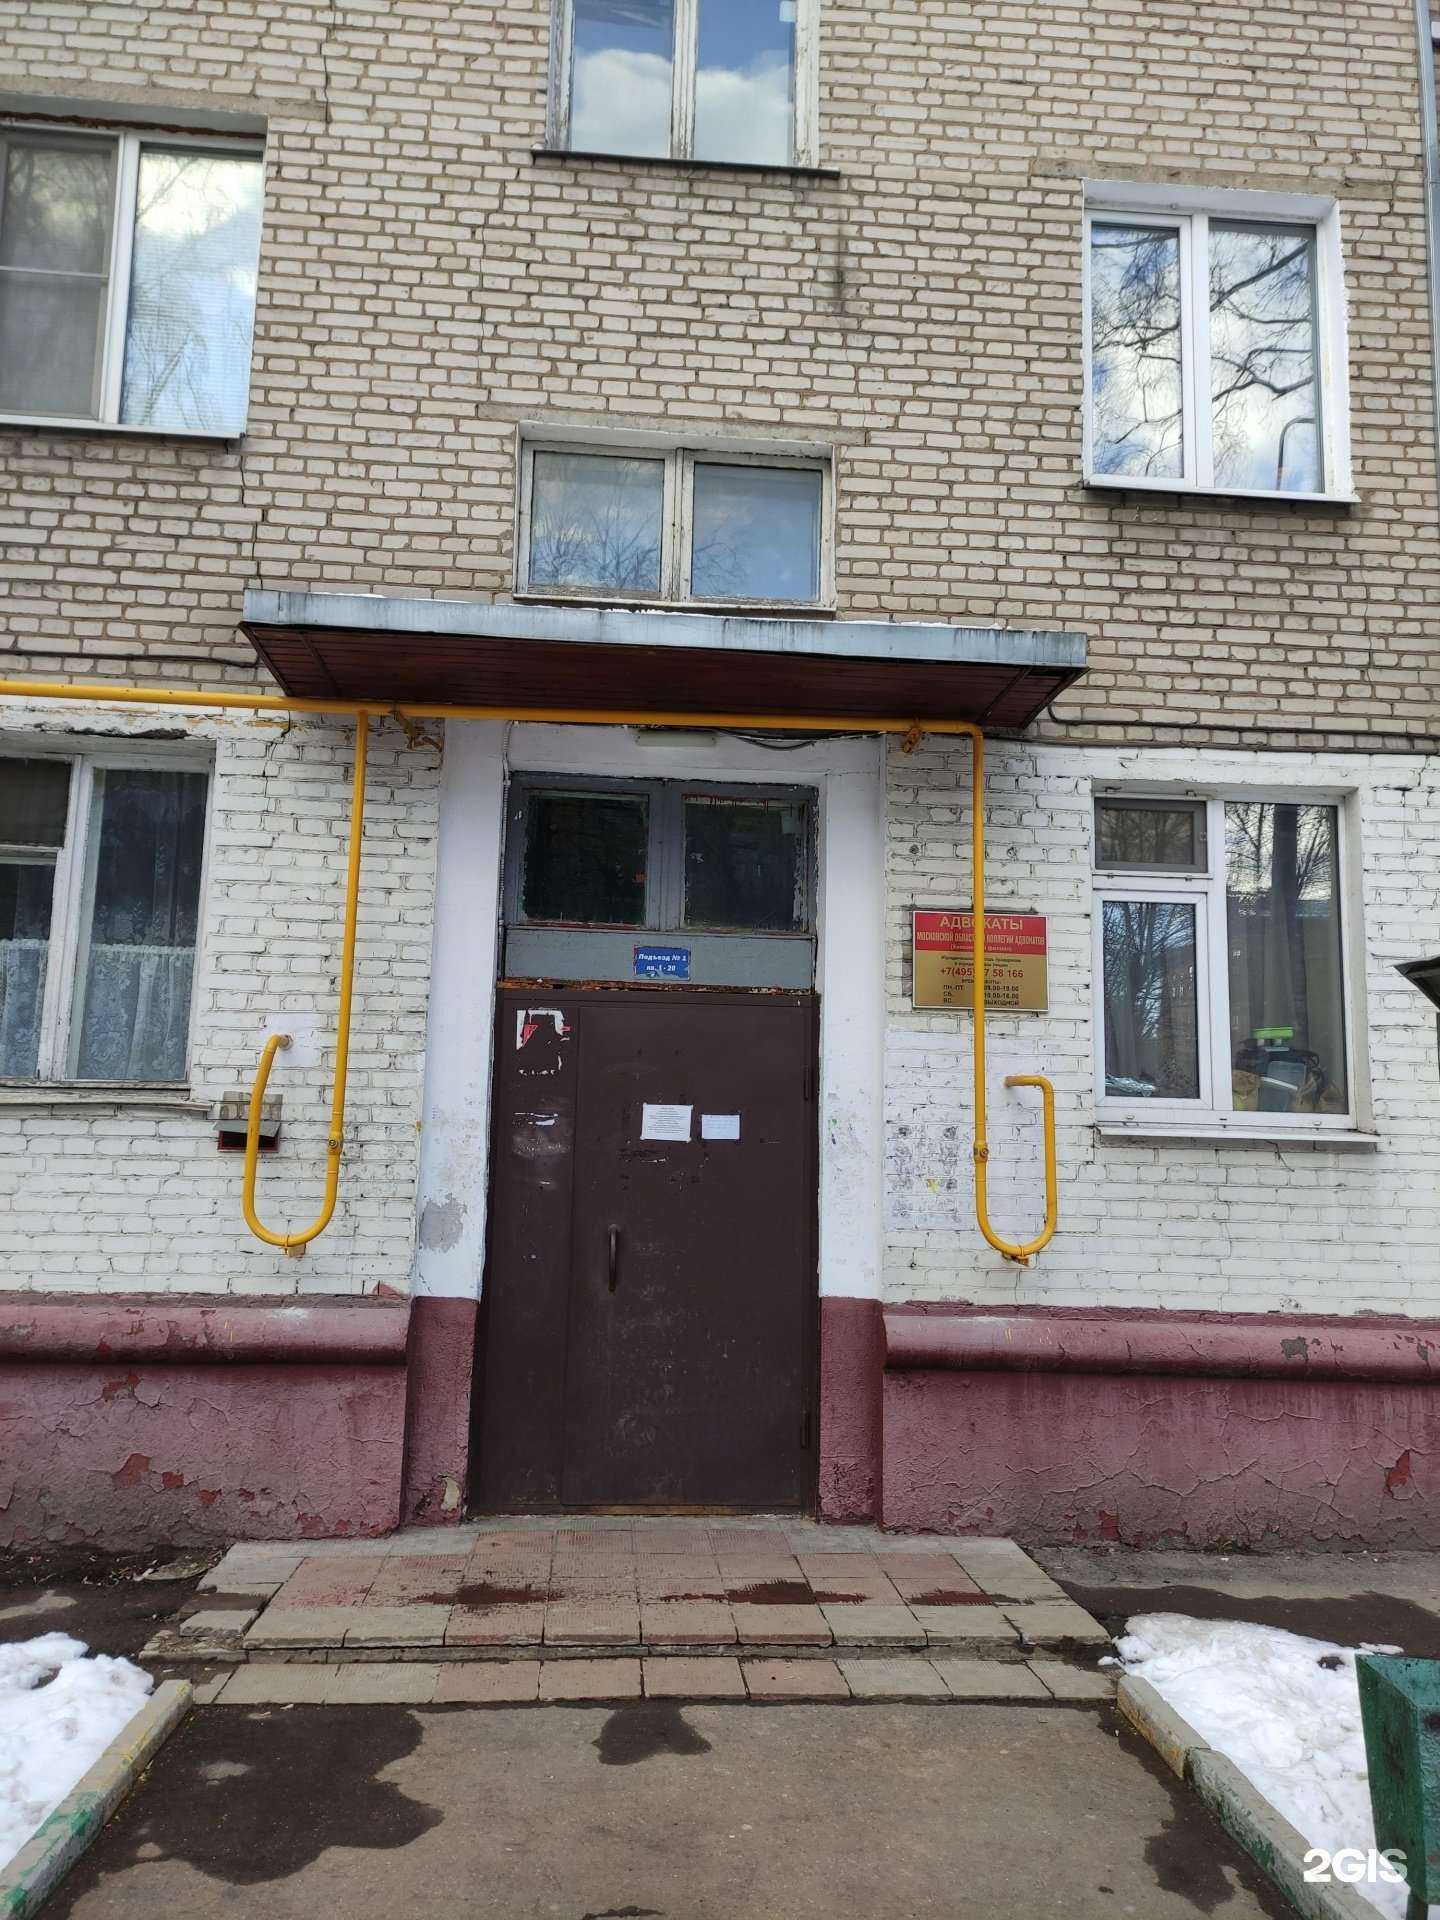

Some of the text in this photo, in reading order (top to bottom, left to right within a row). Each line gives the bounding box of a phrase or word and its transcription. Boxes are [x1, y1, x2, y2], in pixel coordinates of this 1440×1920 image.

[916, 931, 954, 942] МОСКОВСКОЙ
[1014, 936, 1045, 945] АДВОКАТОВ
[638, 953, 671, 961] Подъезд
[992, 970, 1004, 978] 58
